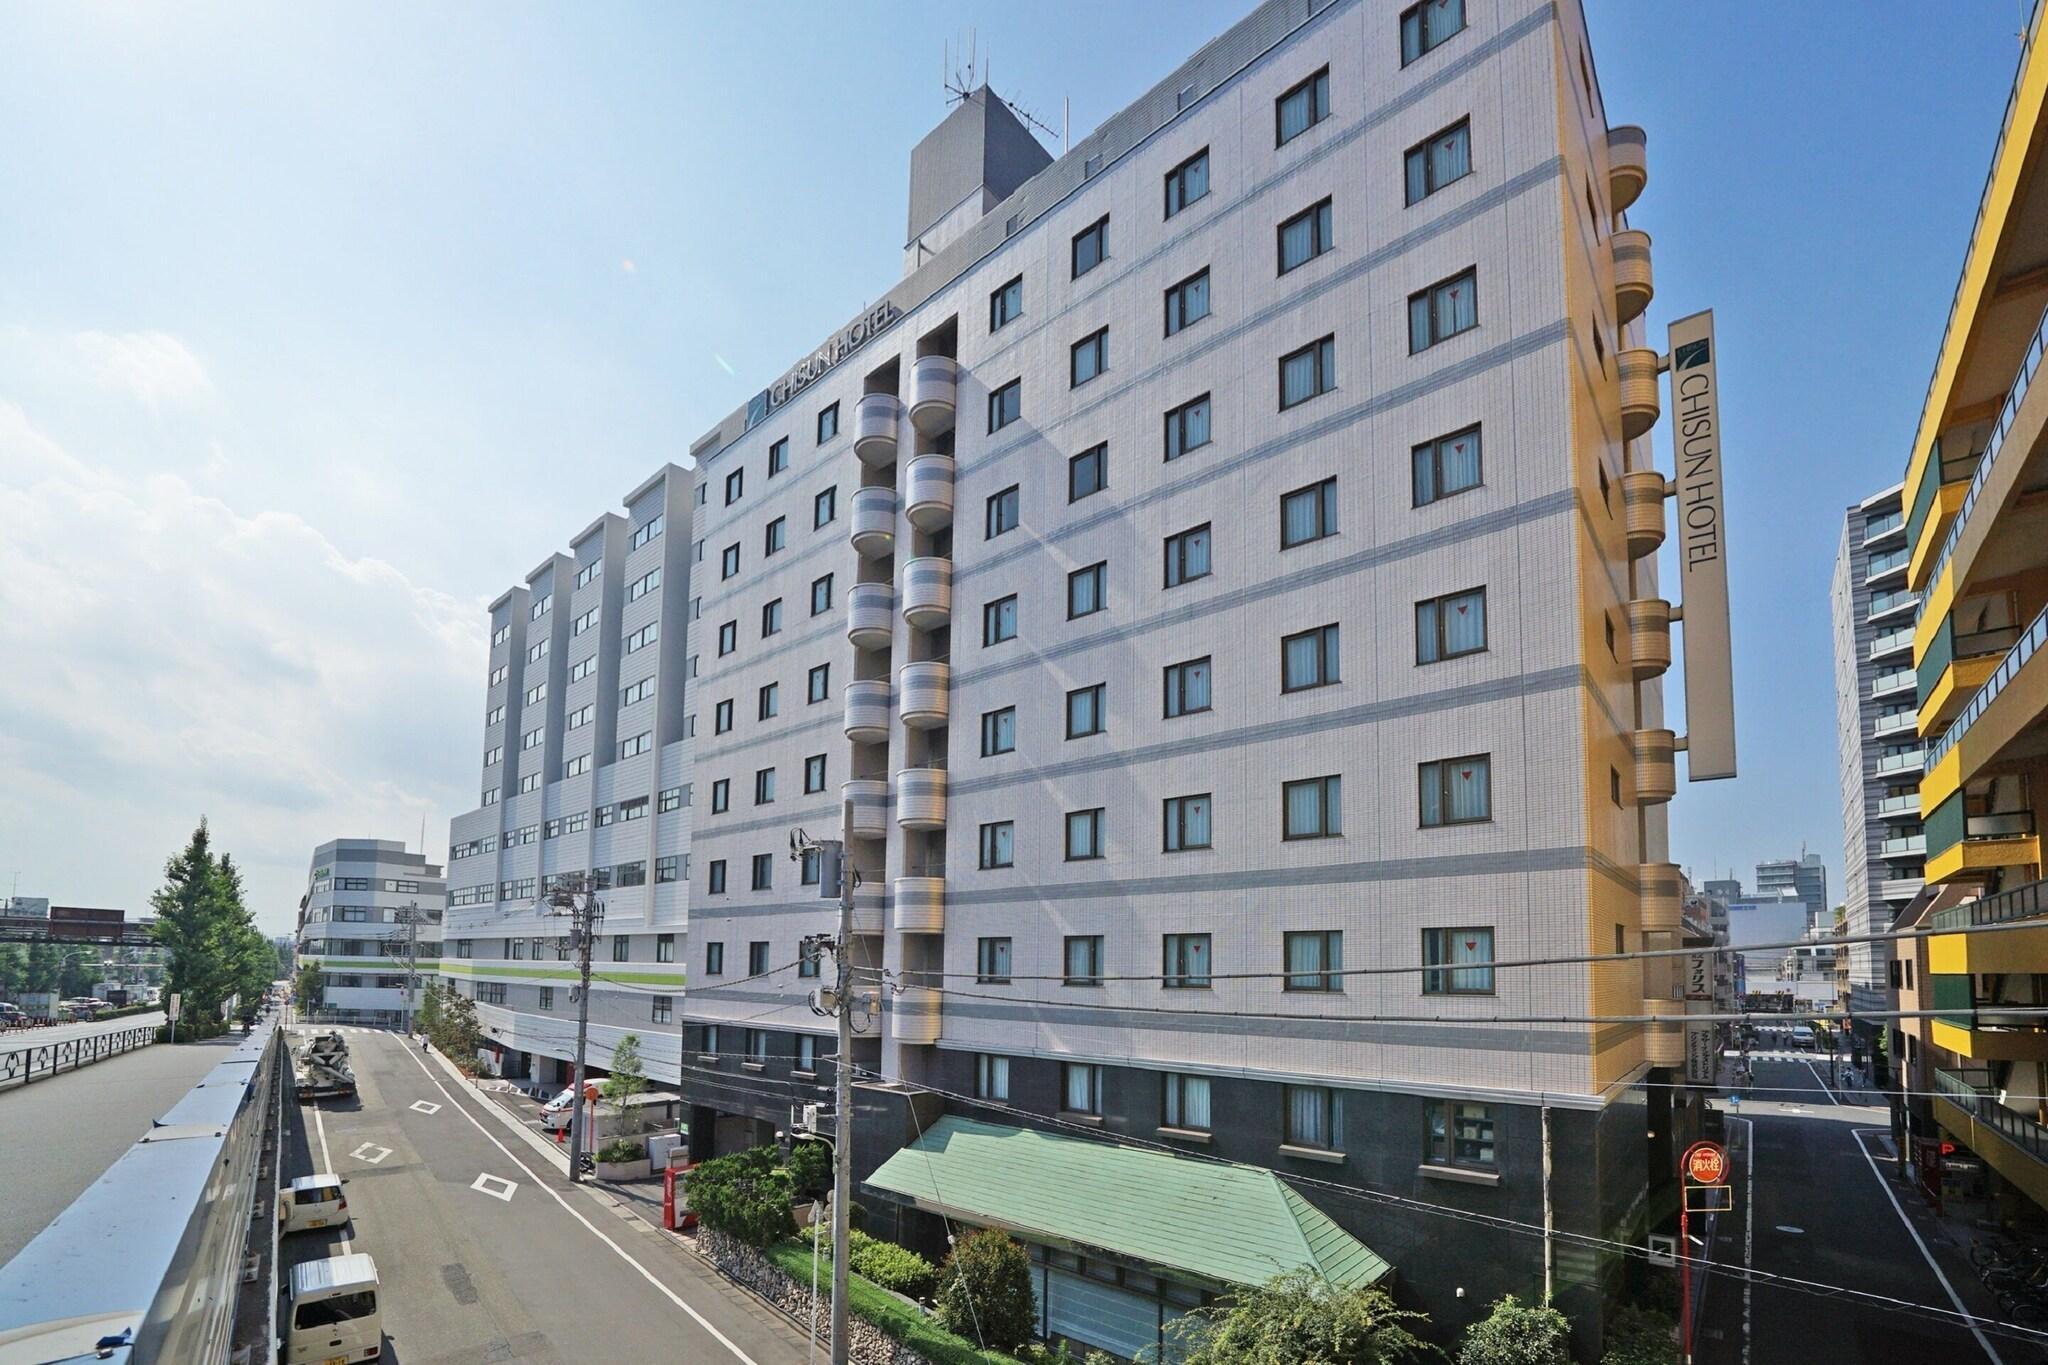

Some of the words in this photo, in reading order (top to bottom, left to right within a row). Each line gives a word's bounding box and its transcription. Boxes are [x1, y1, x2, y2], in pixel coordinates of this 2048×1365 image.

[771, 344, 832, 407] CHISUN
[836, 300, 894, 360] HOTEL
[1680, 374, 1713, 479] CHISUN
[1685, 481, 1718, 573] HOTEL
[1692, 1158, 1720, 1172] 消火栓
